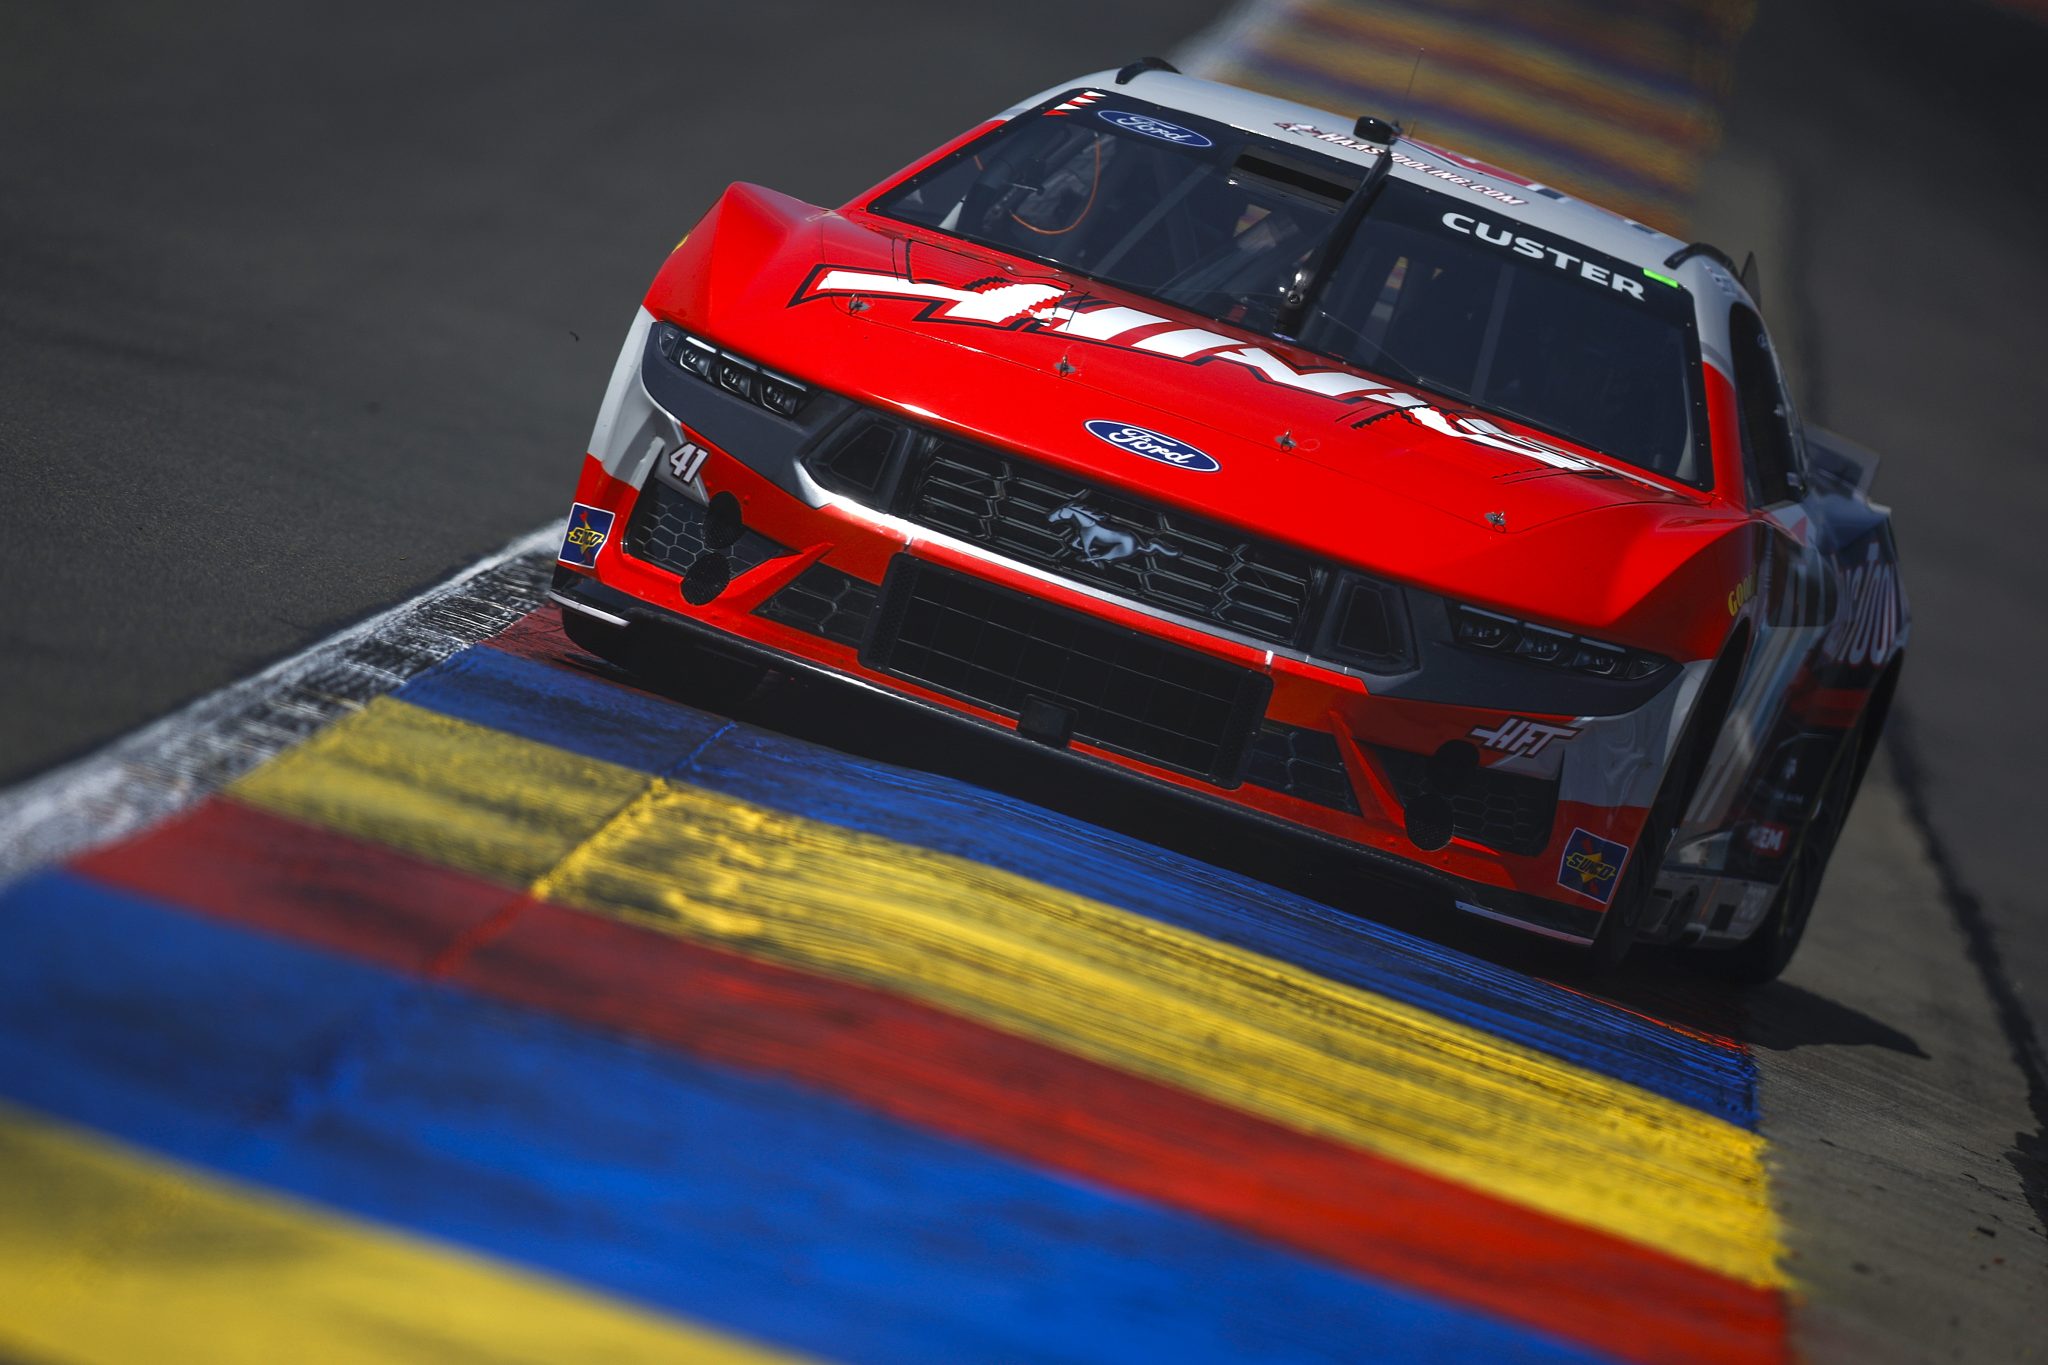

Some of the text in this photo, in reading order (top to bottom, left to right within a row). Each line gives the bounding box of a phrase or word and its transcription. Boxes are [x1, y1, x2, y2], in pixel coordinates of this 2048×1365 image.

[1116, 115, 1193, 141] Ford
[1442, 212, 1645, 301] CUSTER
[669, 442, 709, 484] 41
[1108, 427, 1196, 464] Ford
